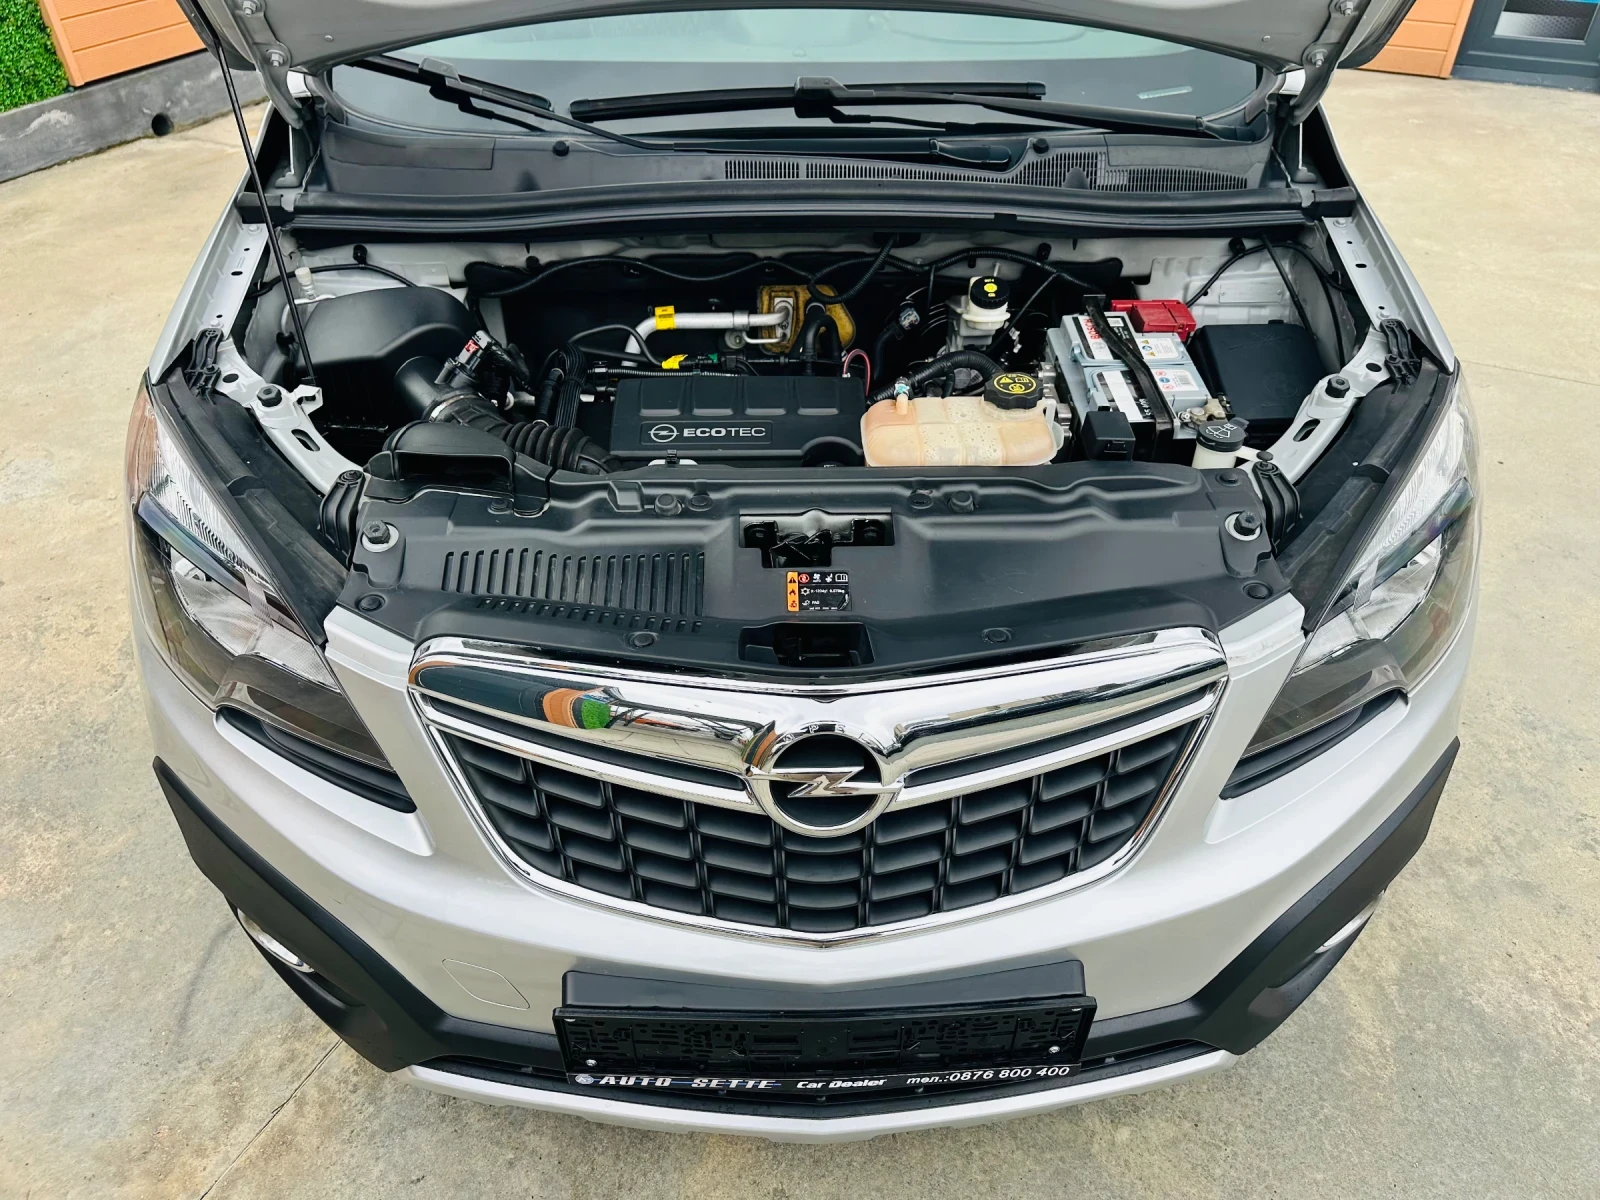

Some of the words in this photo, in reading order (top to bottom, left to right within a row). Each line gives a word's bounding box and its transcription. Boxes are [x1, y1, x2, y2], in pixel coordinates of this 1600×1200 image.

[683, 427, 766, 437] ECOTEC
[998, 1068, 1032, 1079] 800
[1036, 1066, 1070, 1077] 400
[599, 1076, 672, 1087] AUTO
[691, 1078, 776, 1089] SETTE
[796, 1081, 826, 1089] Car
[828, 1079, 888, 1088] Dealer
